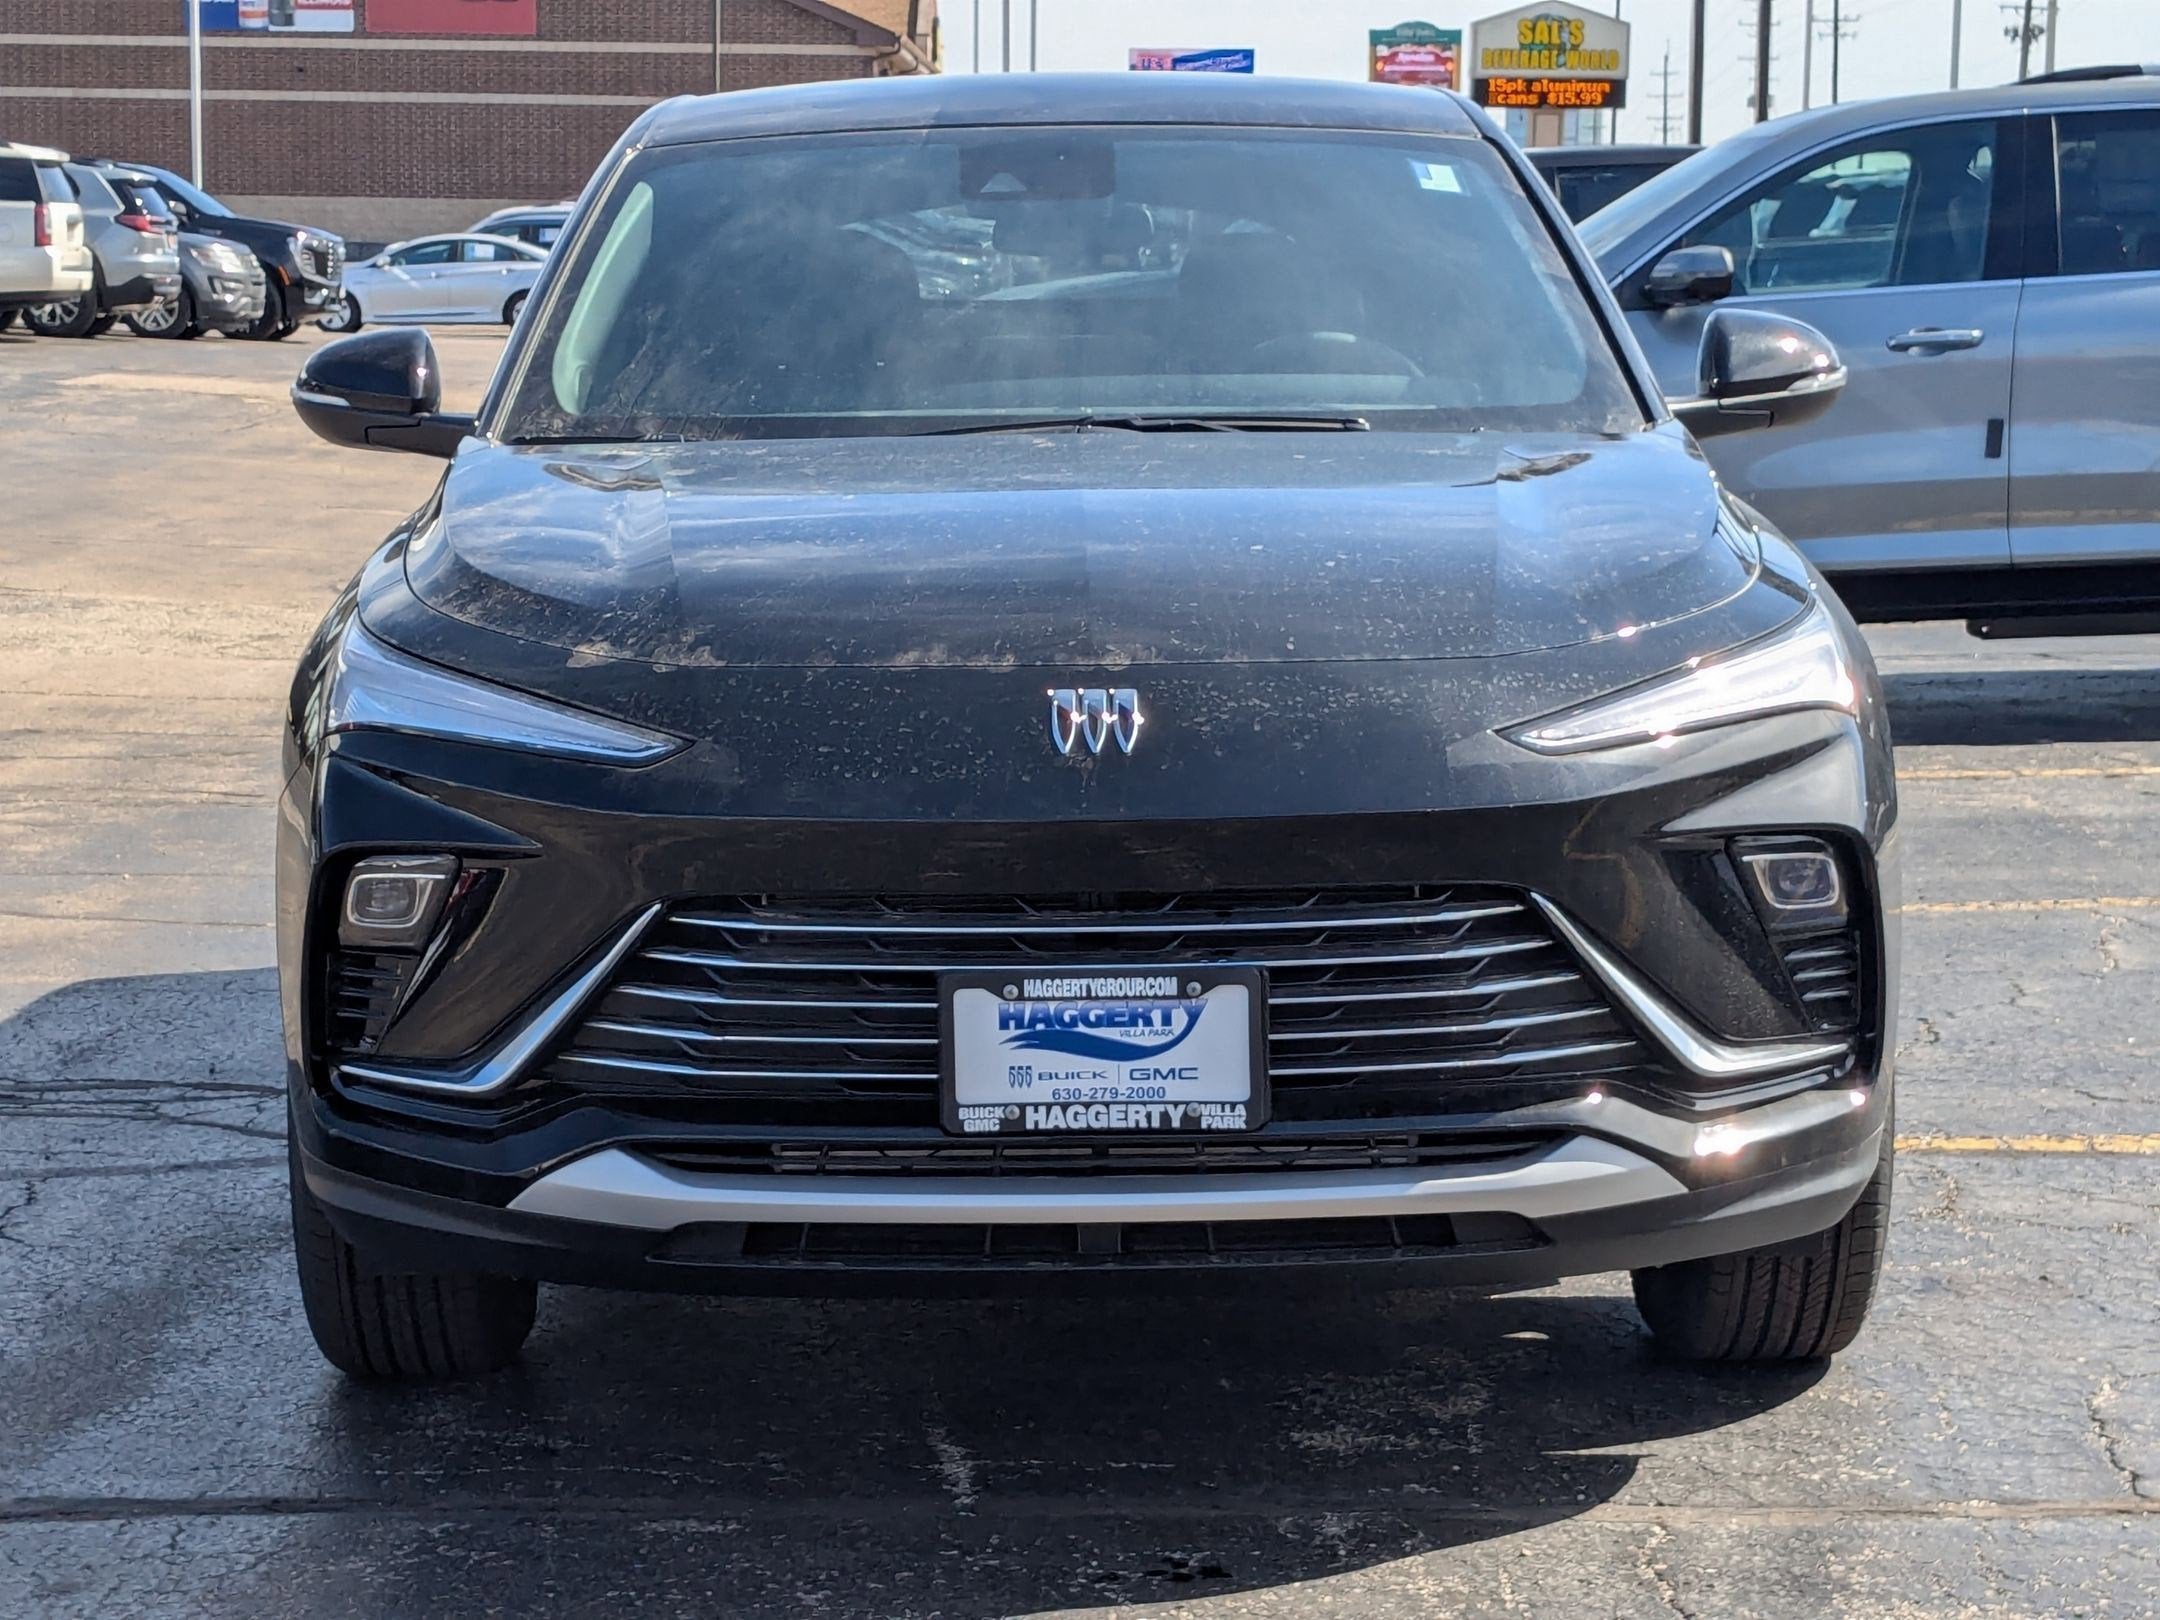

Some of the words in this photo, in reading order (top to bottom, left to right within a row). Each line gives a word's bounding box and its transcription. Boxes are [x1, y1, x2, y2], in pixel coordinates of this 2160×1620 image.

[1565, 49, 1619, 71] WORLD
[1488, 78, 1527, 93] 15pk
[1546, 92, 1603, 105] $15.99
[998, 998, 1207, 1031] HAGGERTY
[1119, 1029, 1146, 1038] VILLA
[1147, 1027, 1175, 1037] PARK
[1038, 1070, 1109, 1081] BUICK
[1129, 1067, 1199, 1081] GMC
[1051, 1086, 1166, 1101] 630-279-2000
[958, 1106, 1005, 1120] BUICK
[1025, 1104, 1189, 1130] HAGGERTY
[1200, 1104, 1246, 1117] VILLA
[963, 1118, 1001, 1132] GMC
[1201, 1116, 1247, 1130] PARK
